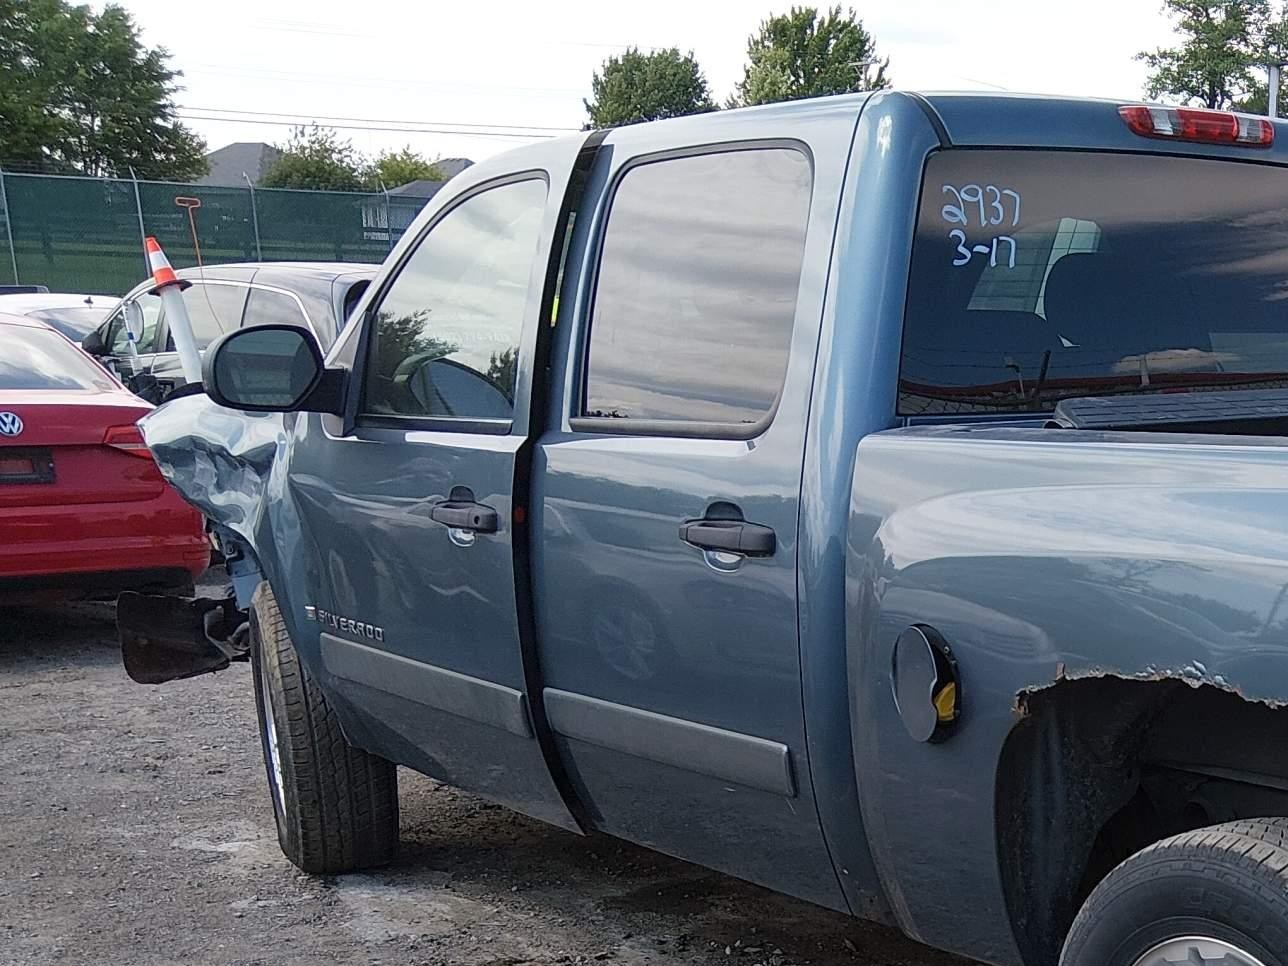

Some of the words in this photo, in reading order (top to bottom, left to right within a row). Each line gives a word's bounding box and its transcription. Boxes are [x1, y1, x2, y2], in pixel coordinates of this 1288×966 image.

[942, 184, 1020, 227] 2937
[949, 229, 1016, 269] 3-17
[317, 609, 384, 641] SILVERADO
